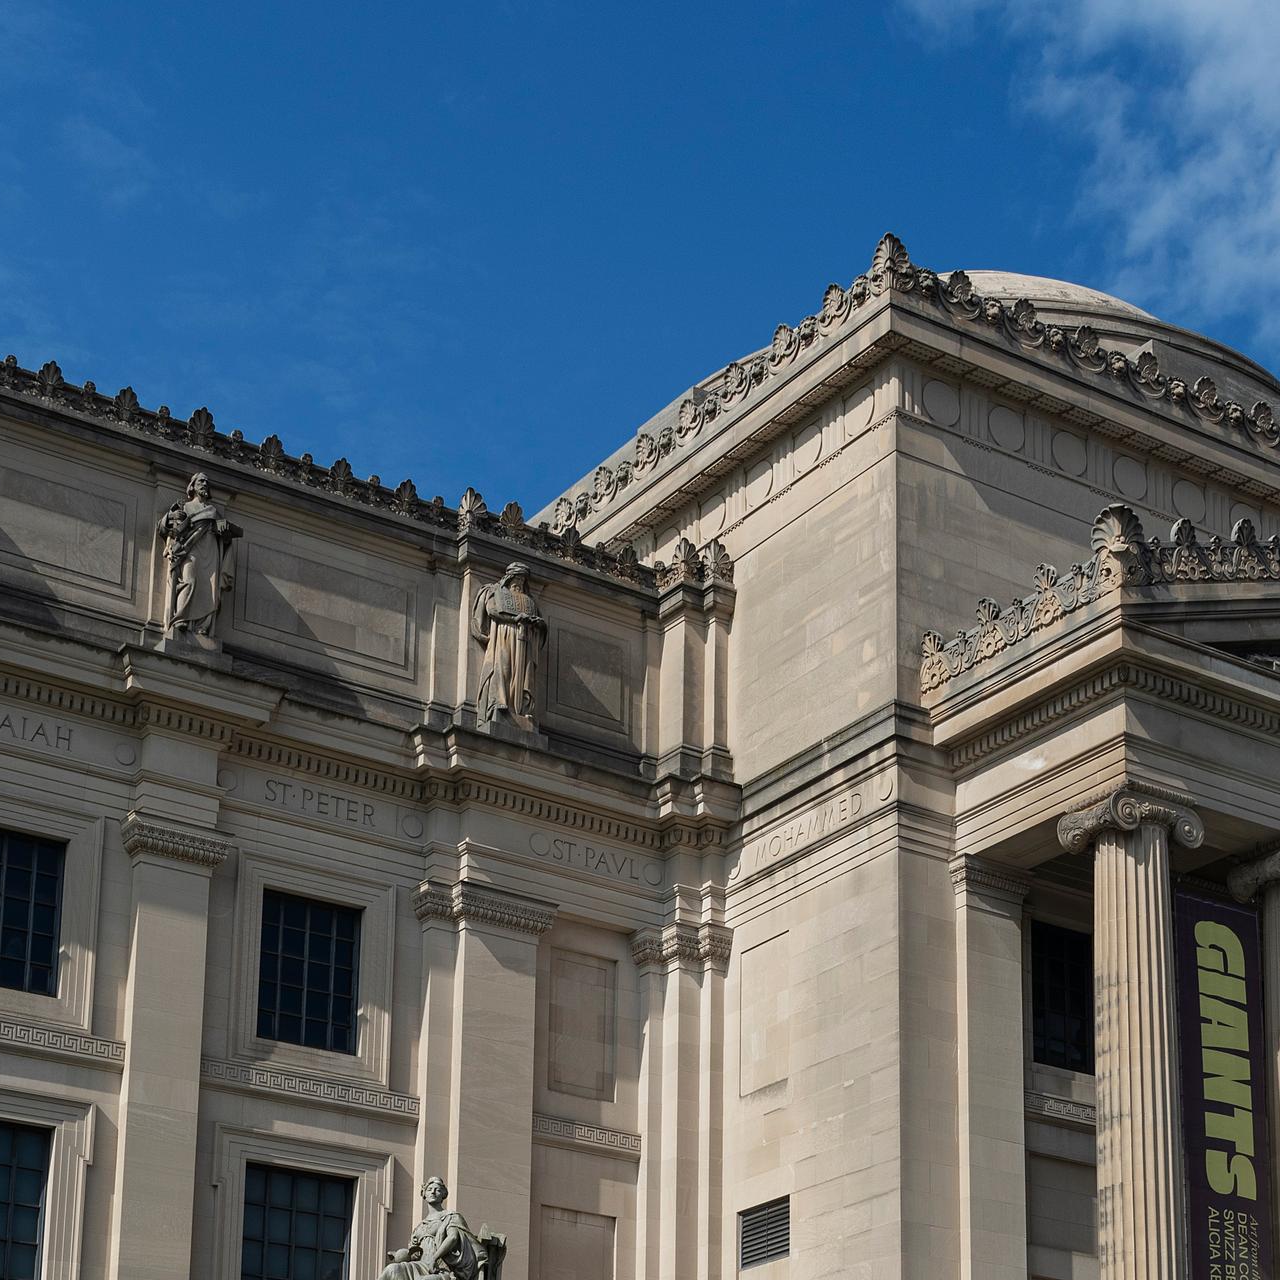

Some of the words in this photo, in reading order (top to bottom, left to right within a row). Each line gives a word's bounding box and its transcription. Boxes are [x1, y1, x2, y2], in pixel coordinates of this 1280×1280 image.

[753, 793, 863, 867] MOHAMMED
[1194, 919, 1257, 1201] GIANTS
[1207, 1205, 1221, 1261] ALICIA
[1223, 1208, 1236, 1262] SWIZZ
[1237, 1211, 1249, 1260] DEAN
[1249, 1214, 1260, 1236] Art
[1249, 1236, 1260, 1268] from
